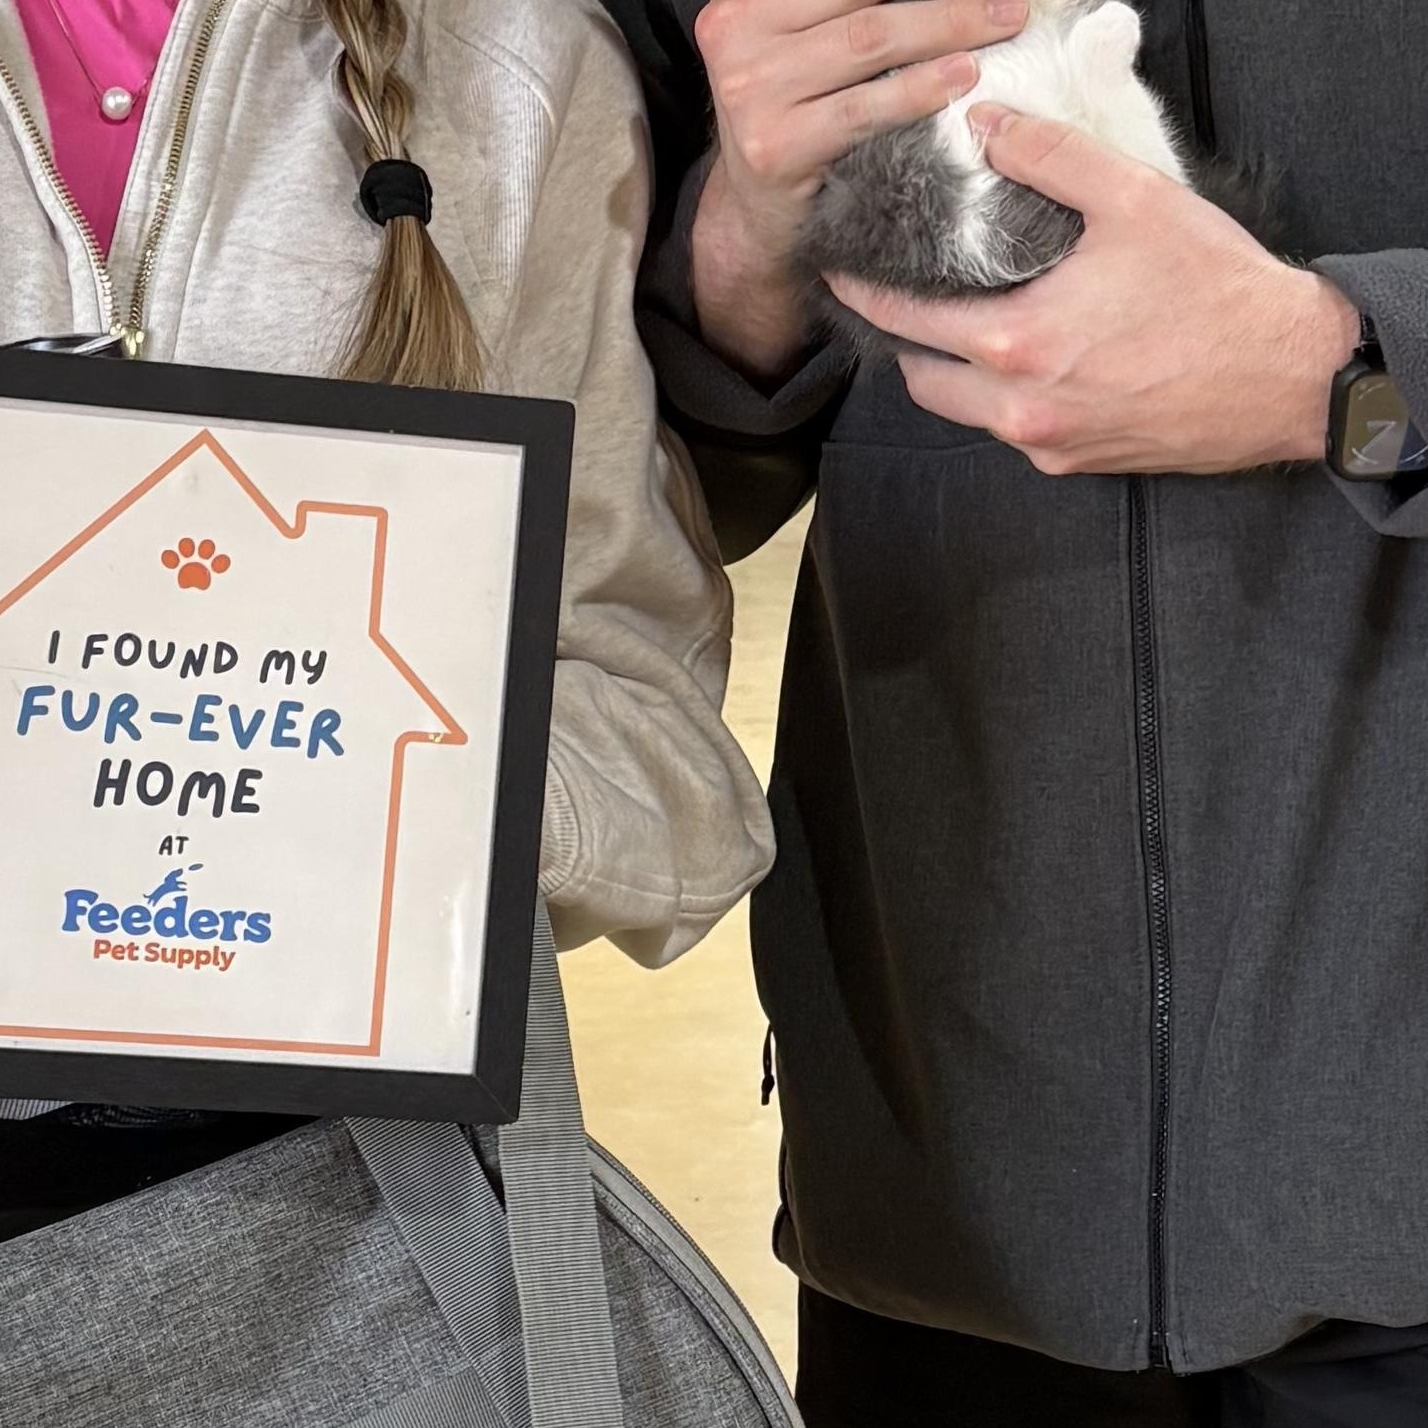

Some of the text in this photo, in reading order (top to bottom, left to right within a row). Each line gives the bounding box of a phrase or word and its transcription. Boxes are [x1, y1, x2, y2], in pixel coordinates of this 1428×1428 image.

[48, 630, 328, 685] I FOUND MY
[16, 684, 345, 759] FUR-EVER
[92, 758, 264, 819] HOME
[158, 834, 190, 856] AT
[61, 888, 272, 944] Feeders
[93, 938, 237, 972] Pet Supply
